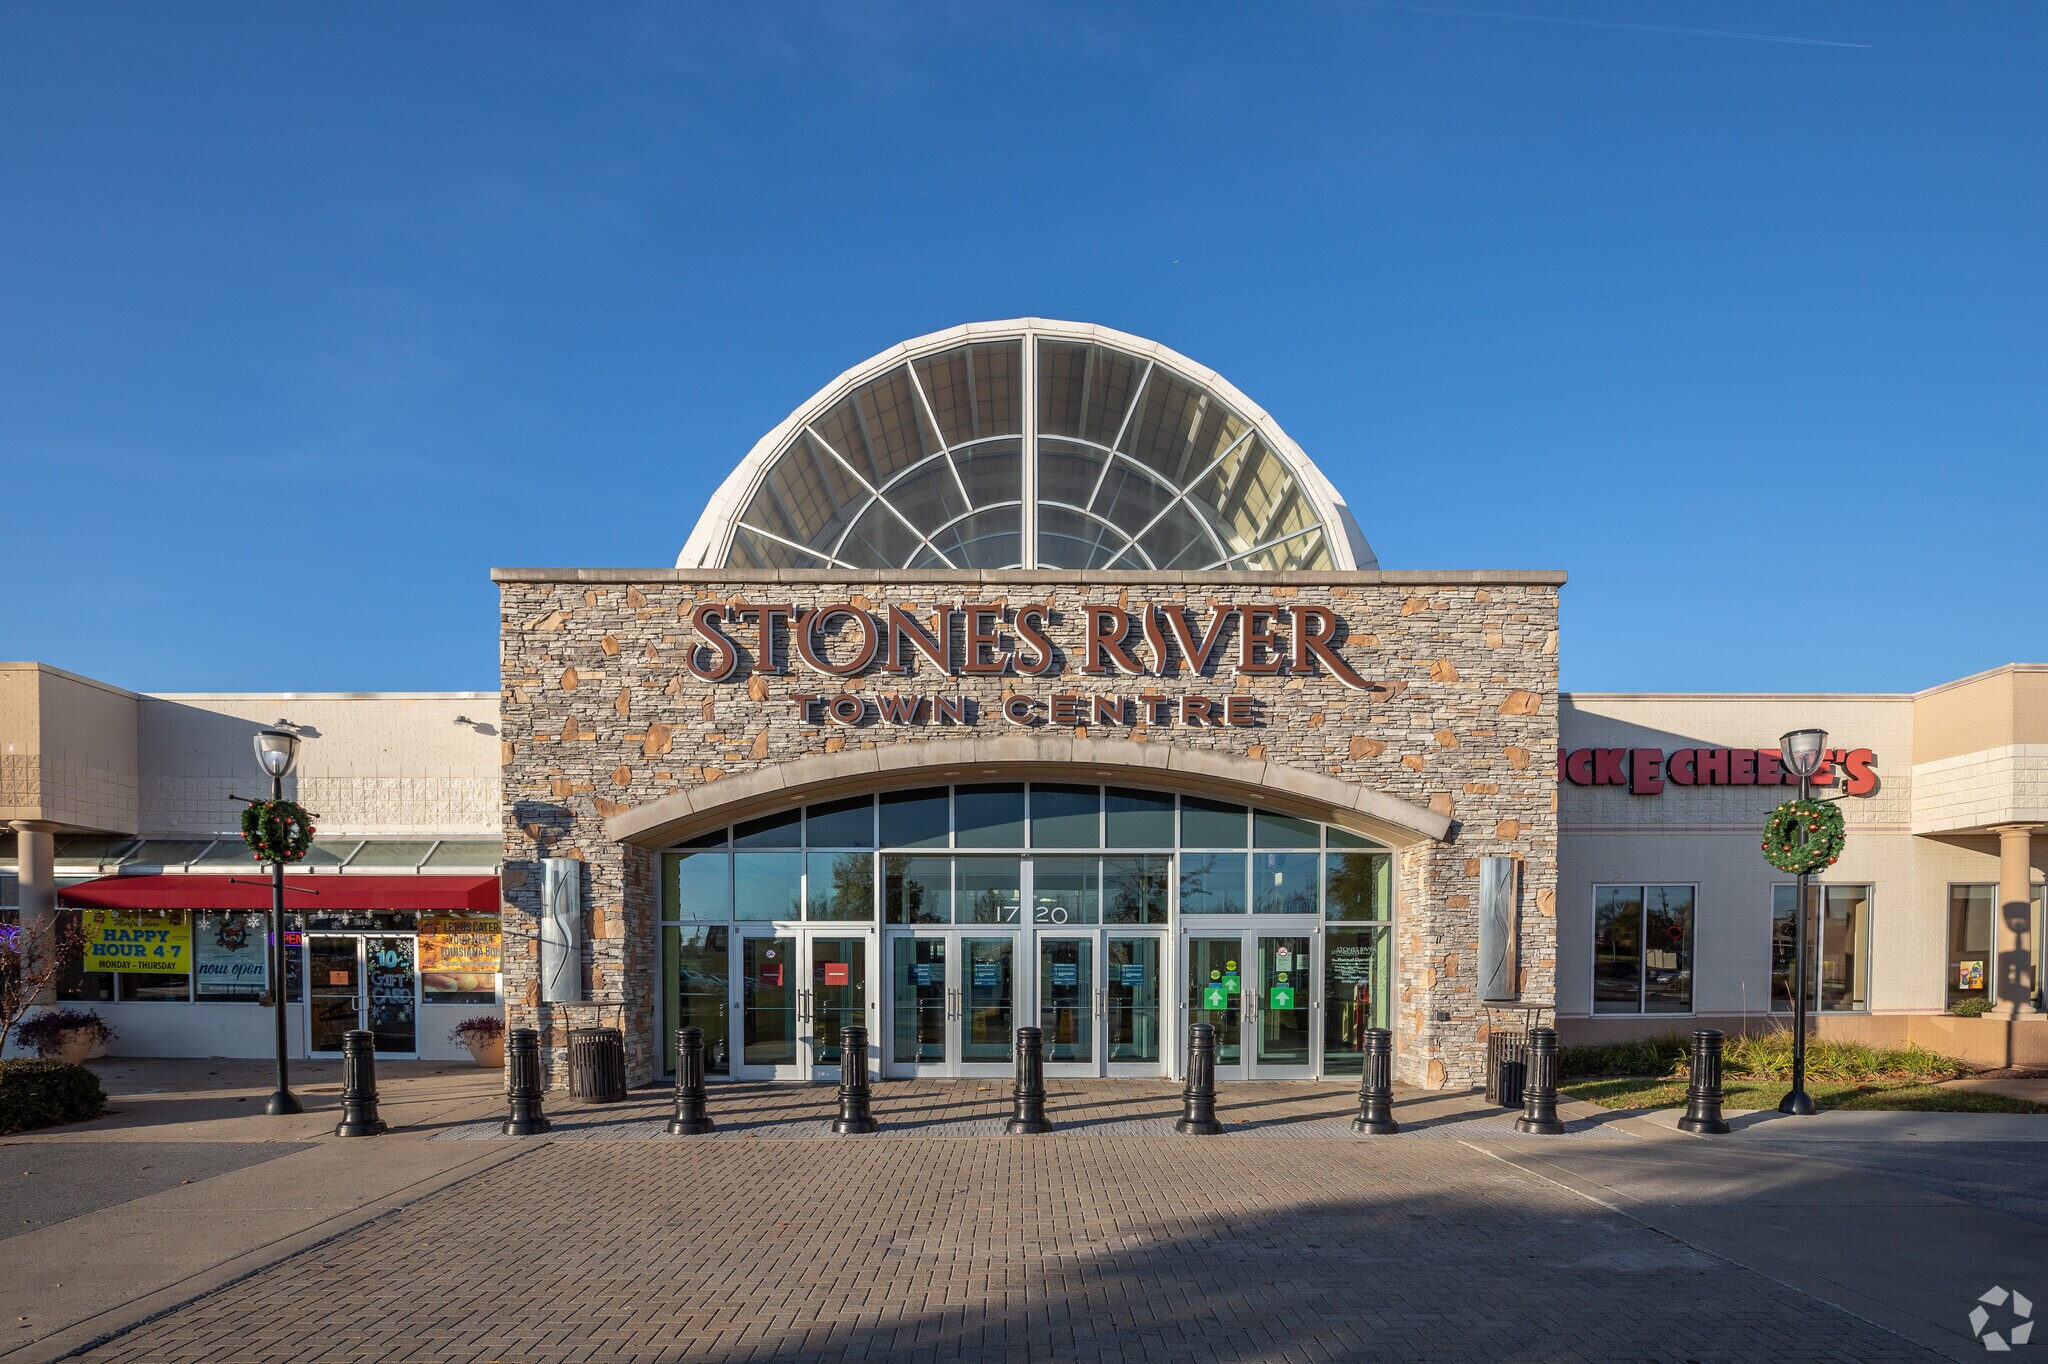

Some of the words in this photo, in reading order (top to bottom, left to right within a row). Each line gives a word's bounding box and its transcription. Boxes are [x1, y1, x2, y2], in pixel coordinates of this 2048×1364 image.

[686, 603, 1054, 682] STONES
[1078, 603, 1375, 691] RIVER
[788, 694, 966, 725] TOWN
[1003, 695, 1255, 725] CENTRE
[1630, 748, 1665, 795] E
[1668, 748, 1875, 795] CHEEE'S
[443, 921, 459, 933] LET
[460, 922, 472, 933] US
[473, 921, 499, 933] CATER
[103, 929, 170, 942] HAPPY
[284, 934, 302, 944] PEN
[449, 934, 470, 945] YOUR
[472, 933, 493, 945] NEXT
[92, 944, 147, 957] HOUR
[153, 945, 182, 958] 4-7
[440, 946, 484, 957] LOUISIANA
[99, 960, 131, 969] MONDAY
[138, 962, 176, 970] THURSDAY
[199, 964, 229, 975] now
[231, 964, 264, 980] open
[371, 970, 405, 988] GIFT
[372, 987, 412, 1005] CARD
